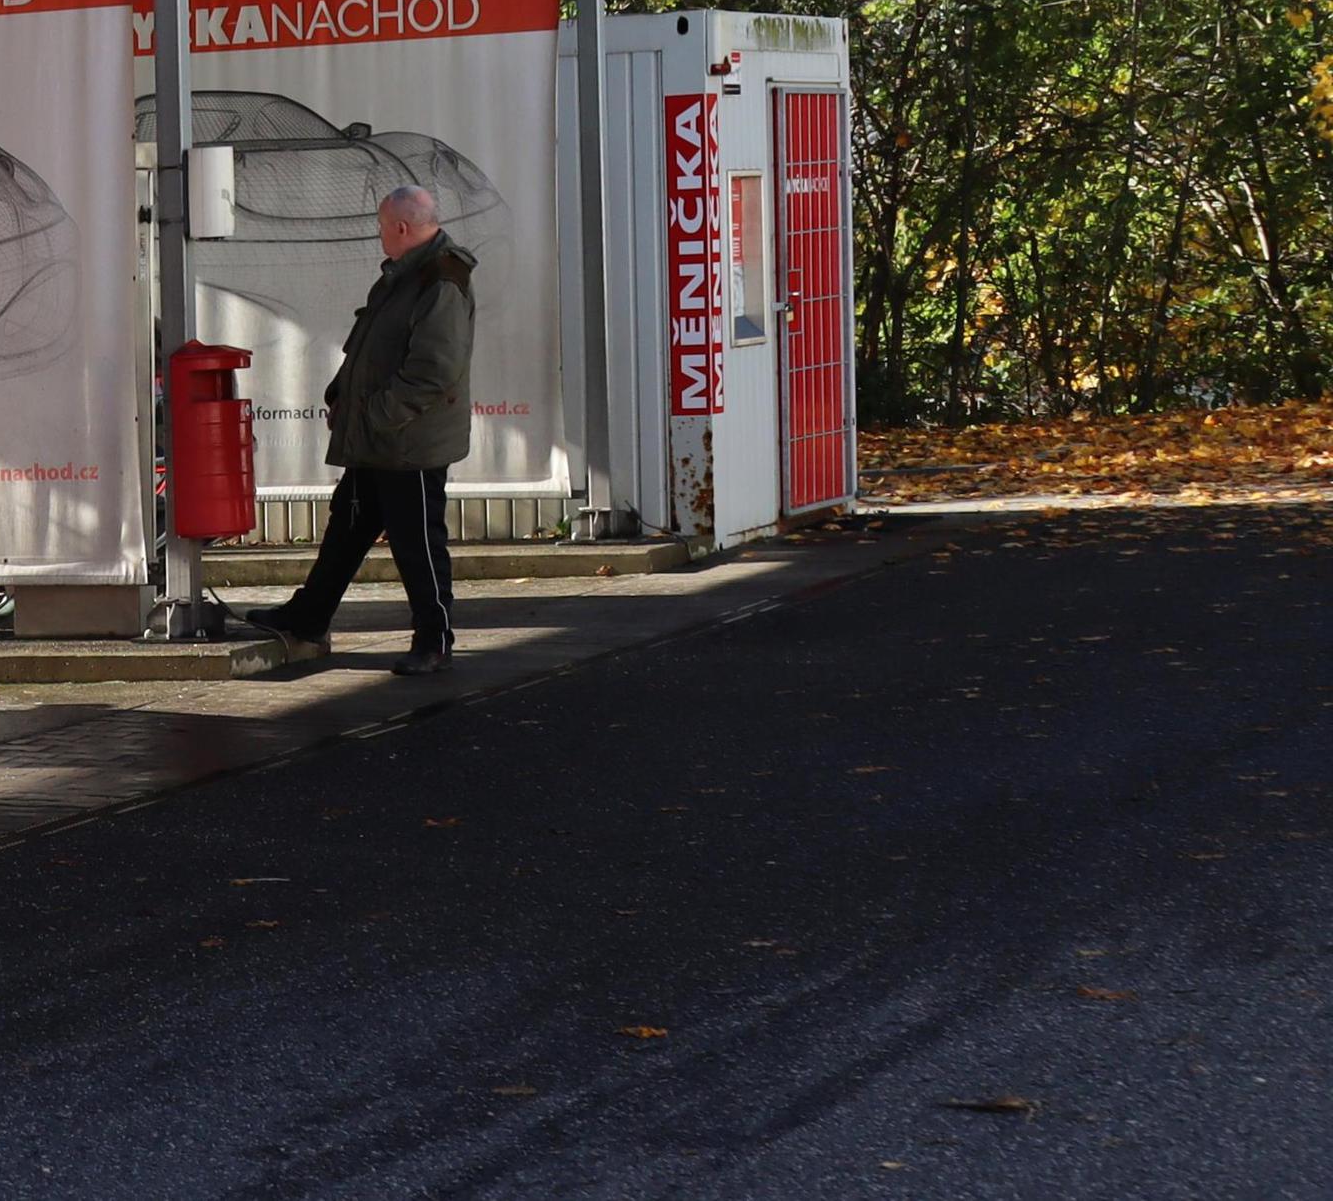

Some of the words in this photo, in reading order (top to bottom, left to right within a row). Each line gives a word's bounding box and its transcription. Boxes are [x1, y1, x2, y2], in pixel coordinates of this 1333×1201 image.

[669, 101, 707, 408] MĚNIČKA
[708, 101, 723, 406] MĚNIČKA
[471, 400, 529, 416] hod.cz
